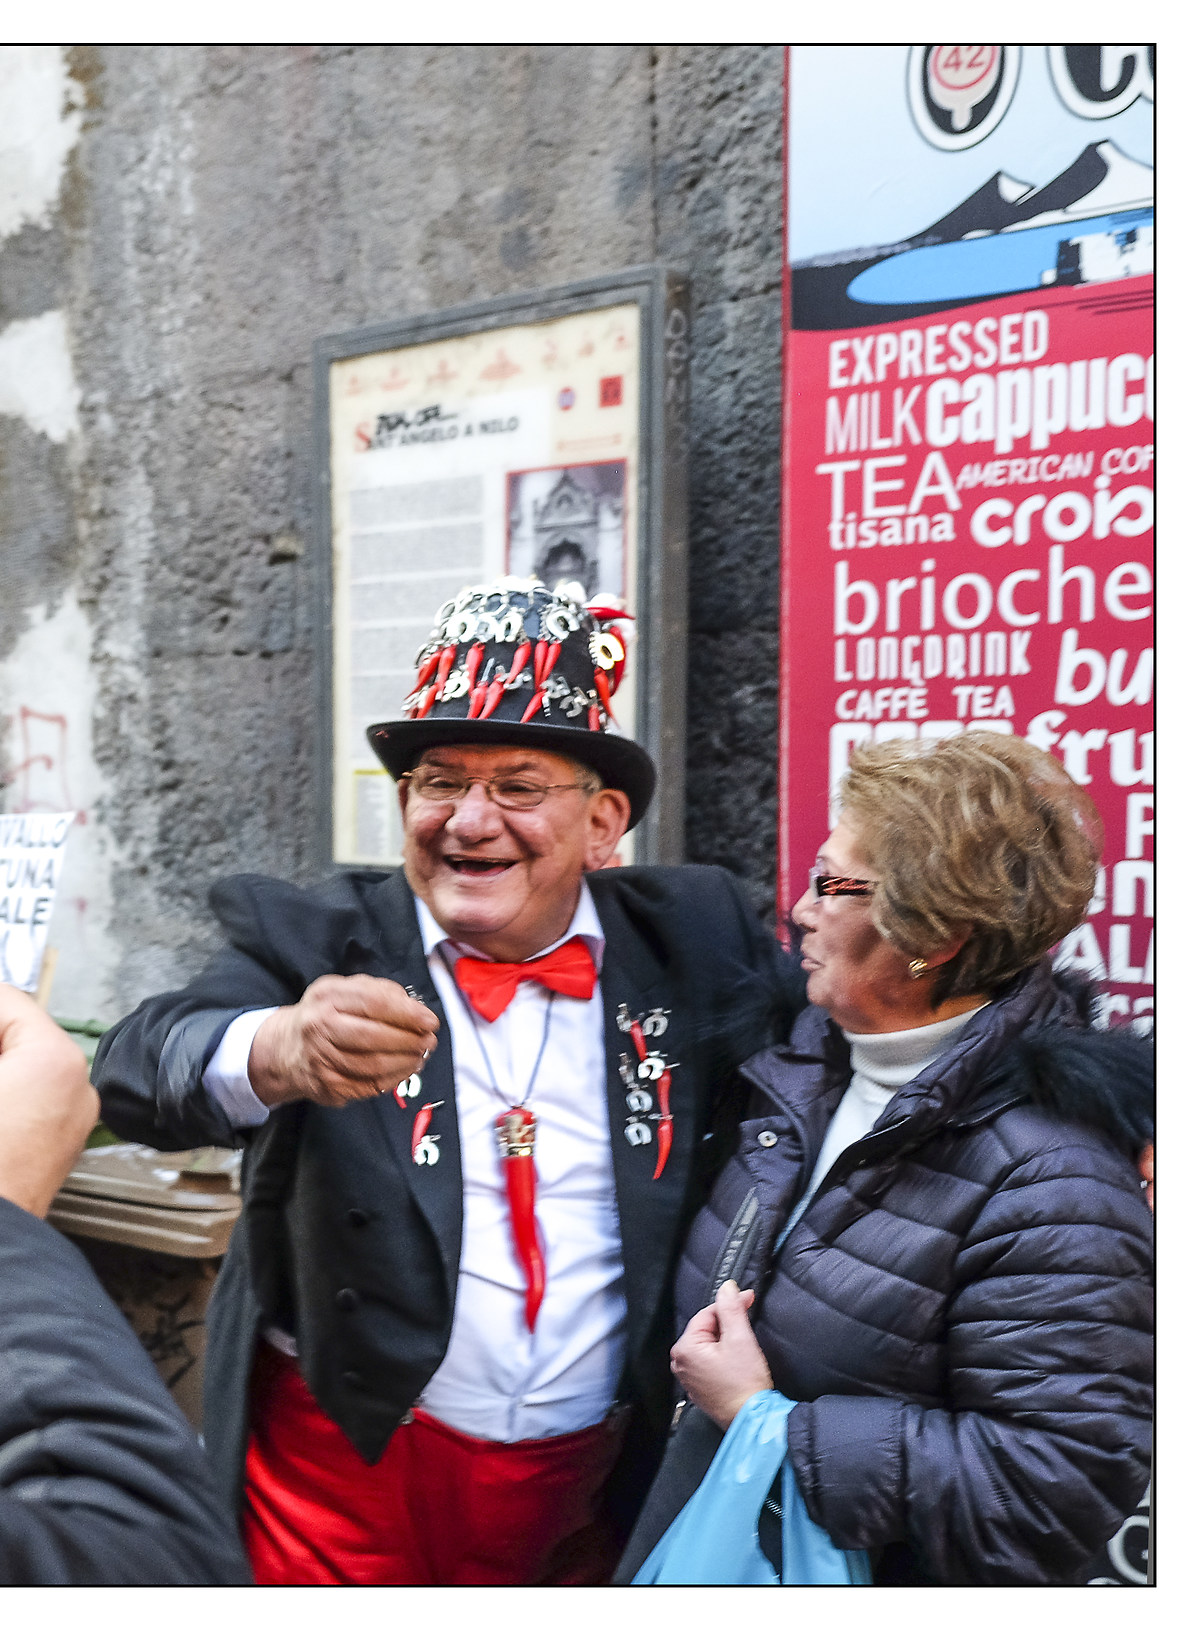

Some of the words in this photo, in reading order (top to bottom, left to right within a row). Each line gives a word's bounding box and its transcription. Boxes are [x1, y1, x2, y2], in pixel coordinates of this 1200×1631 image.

[828, 309, 1049, 389] EXPRESSED
[825, 384, 922, 454] MILK
[926, 352, 1154, 454] cappuc
[815, 450, 961, 519] TEA
[956, 450, 1095, 491] AMERICAN
[828, 511, 956, 550] tisana
[833, 544, 1154, 636] brioche
[1054, 627, 1154, 706] bu
[951, 685, 1016, 719] TEA
[1024, 709, 1154, 787] fru
[1051, 921, 1154, 985] AL
